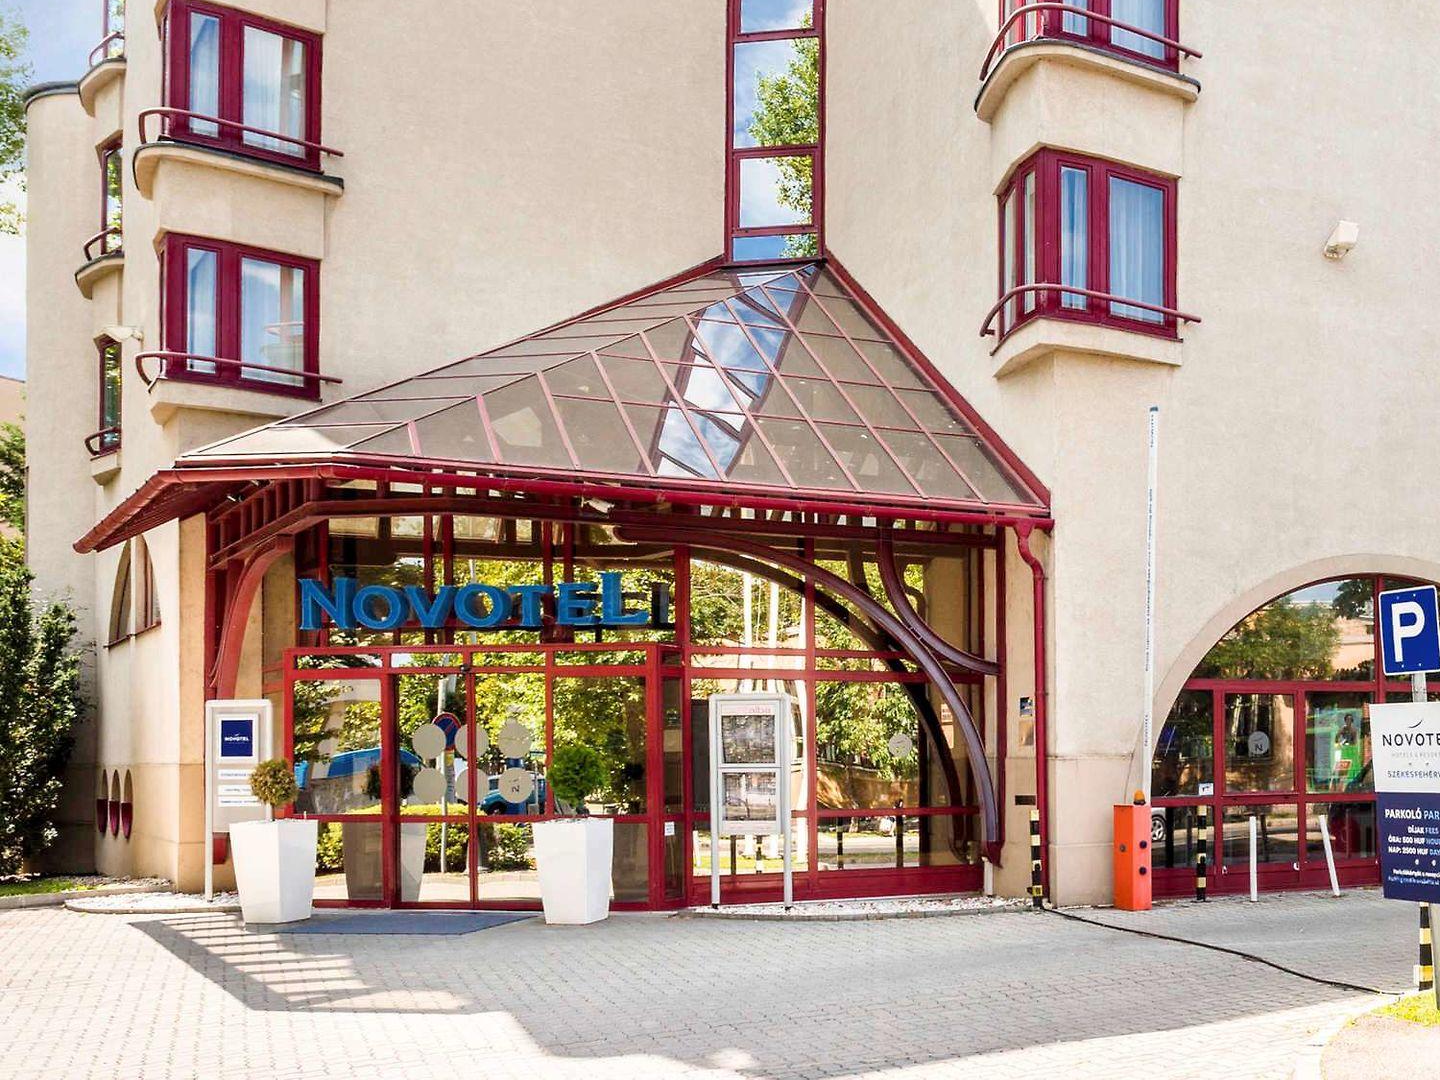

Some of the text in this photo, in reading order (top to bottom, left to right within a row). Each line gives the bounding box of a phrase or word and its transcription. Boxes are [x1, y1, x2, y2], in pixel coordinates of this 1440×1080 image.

[298, 572, 649, 630] NOVOTEL
[1391, 601, 1425, 663] P
[1384, 807, 1422, 819] PARKOLÓ
